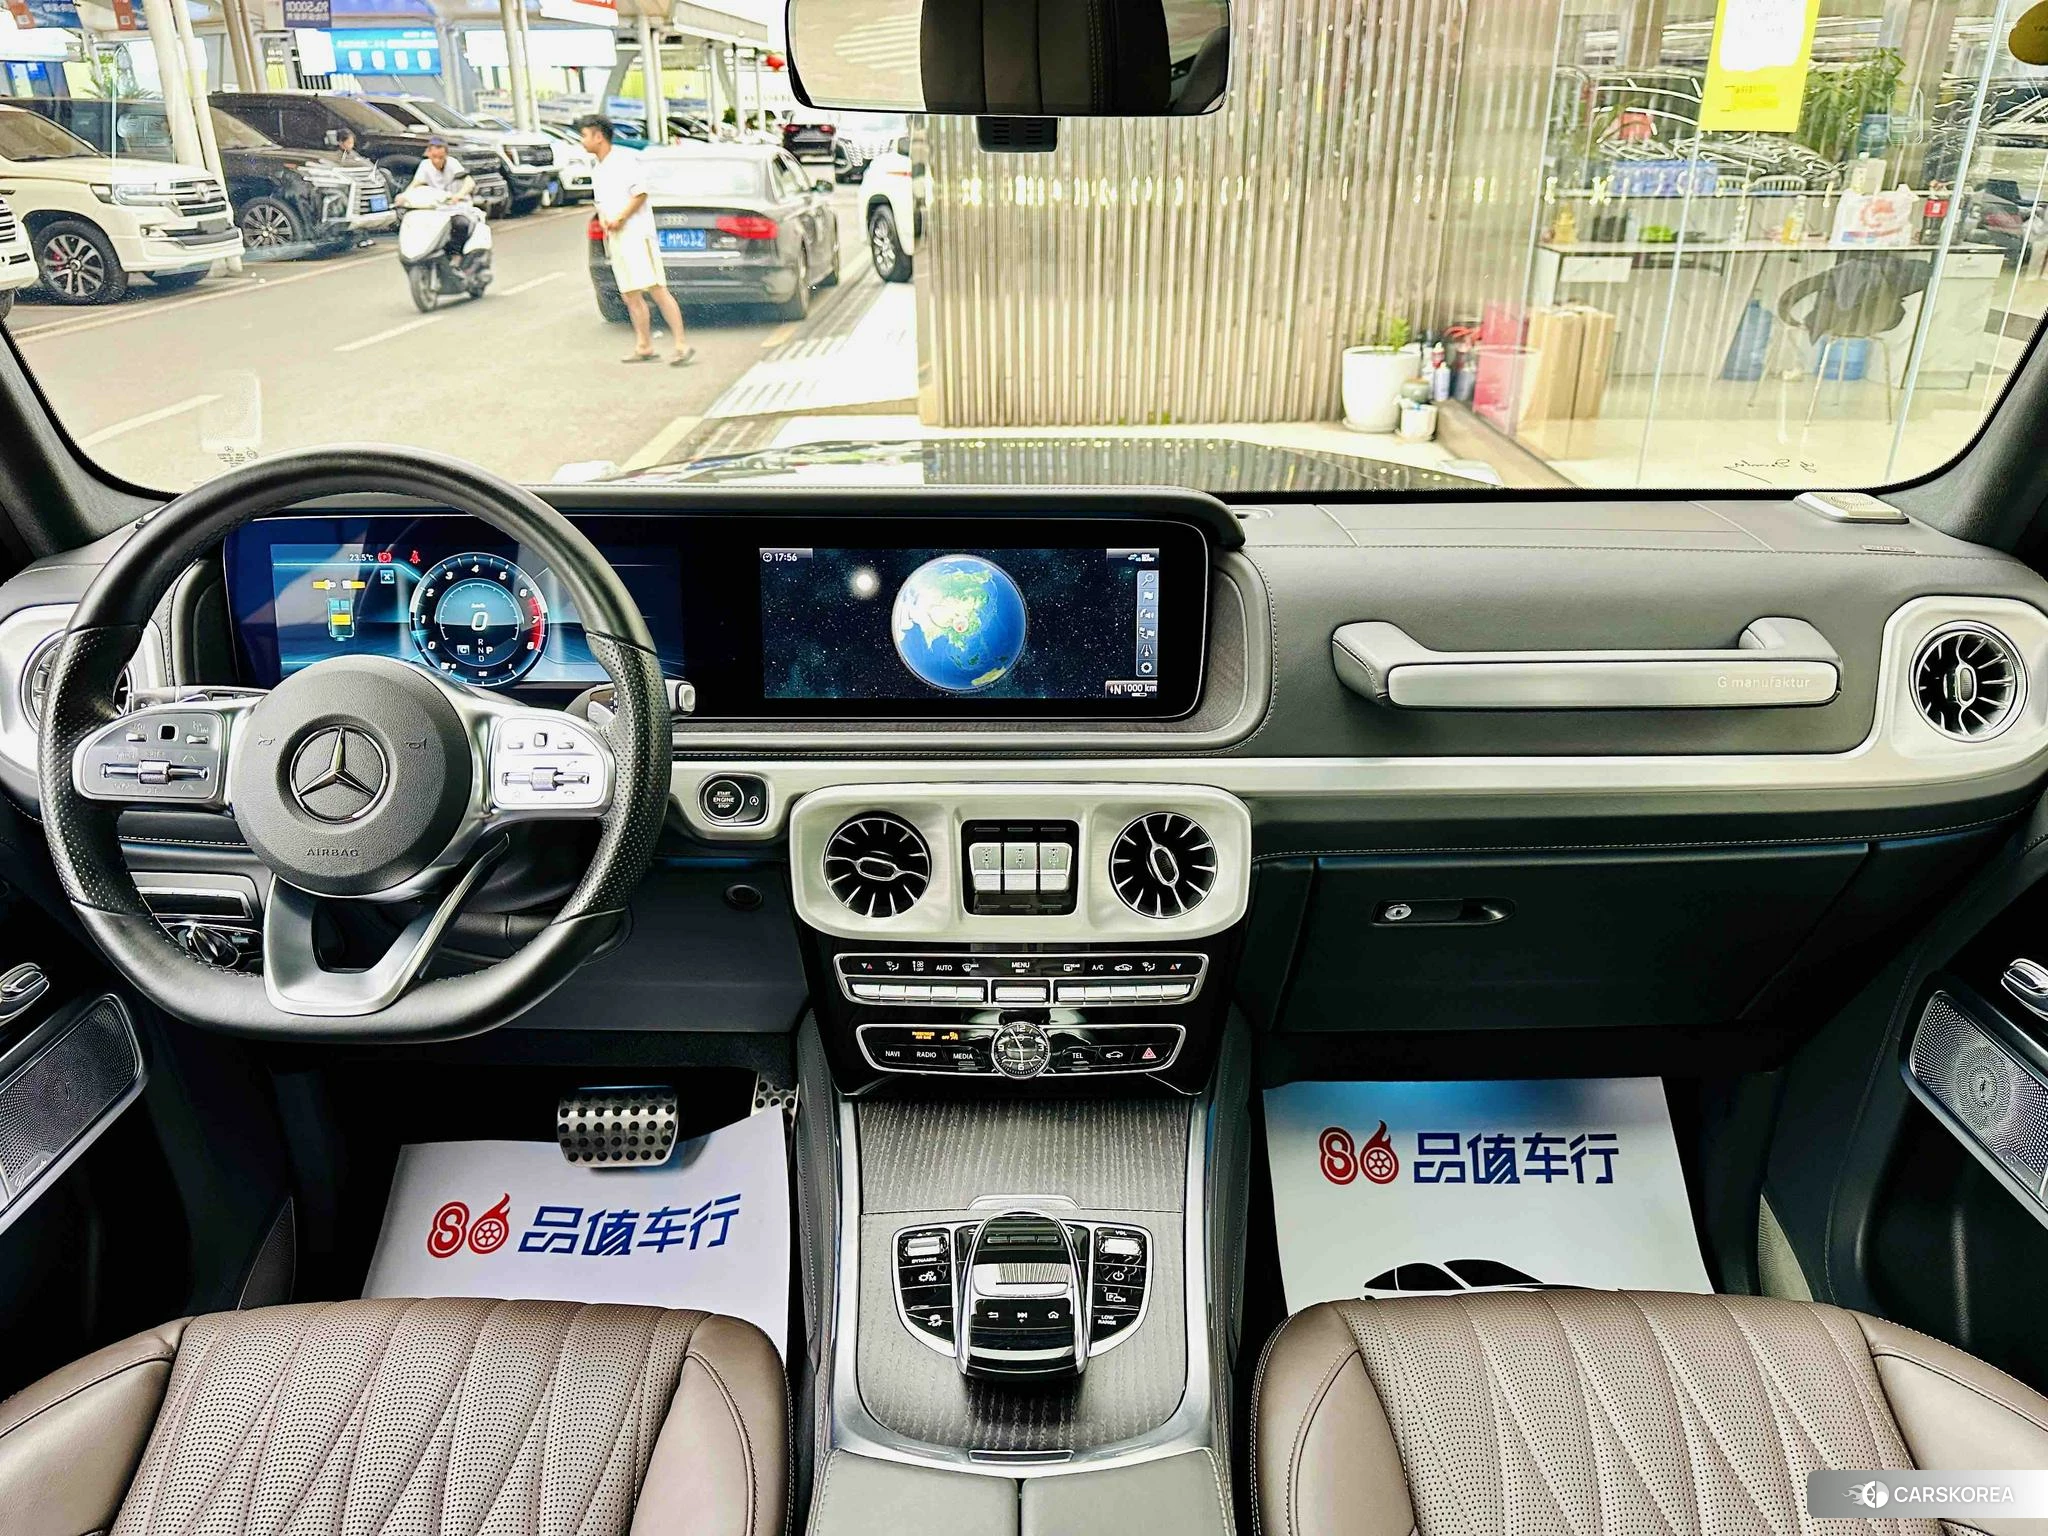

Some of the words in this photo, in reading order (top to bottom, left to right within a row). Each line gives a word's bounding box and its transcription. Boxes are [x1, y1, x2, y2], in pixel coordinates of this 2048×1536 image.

[775, 552, 797, 561] 17:56
[471, 564, 480, 573] 4
[445, 571, 454, 580] 3
[499, 571, 507, 580] 5
[426, 588, 435, 597] 2
[420, 615, 427, 624] 1
[471, 611, 489, 632] 0
[531, 616, 539, 624] 7
[428, 641, 436, 650] 0
[486, 646, 494, 655] P
[1717, 676, 1728, 688] G
[1731, 675, 1811, 688] manufaktur
[1124, 684, 1143, 692] 1000
[1145, 684, 1157, 692] km
[306, 848, 359, 857] AIRBAG
